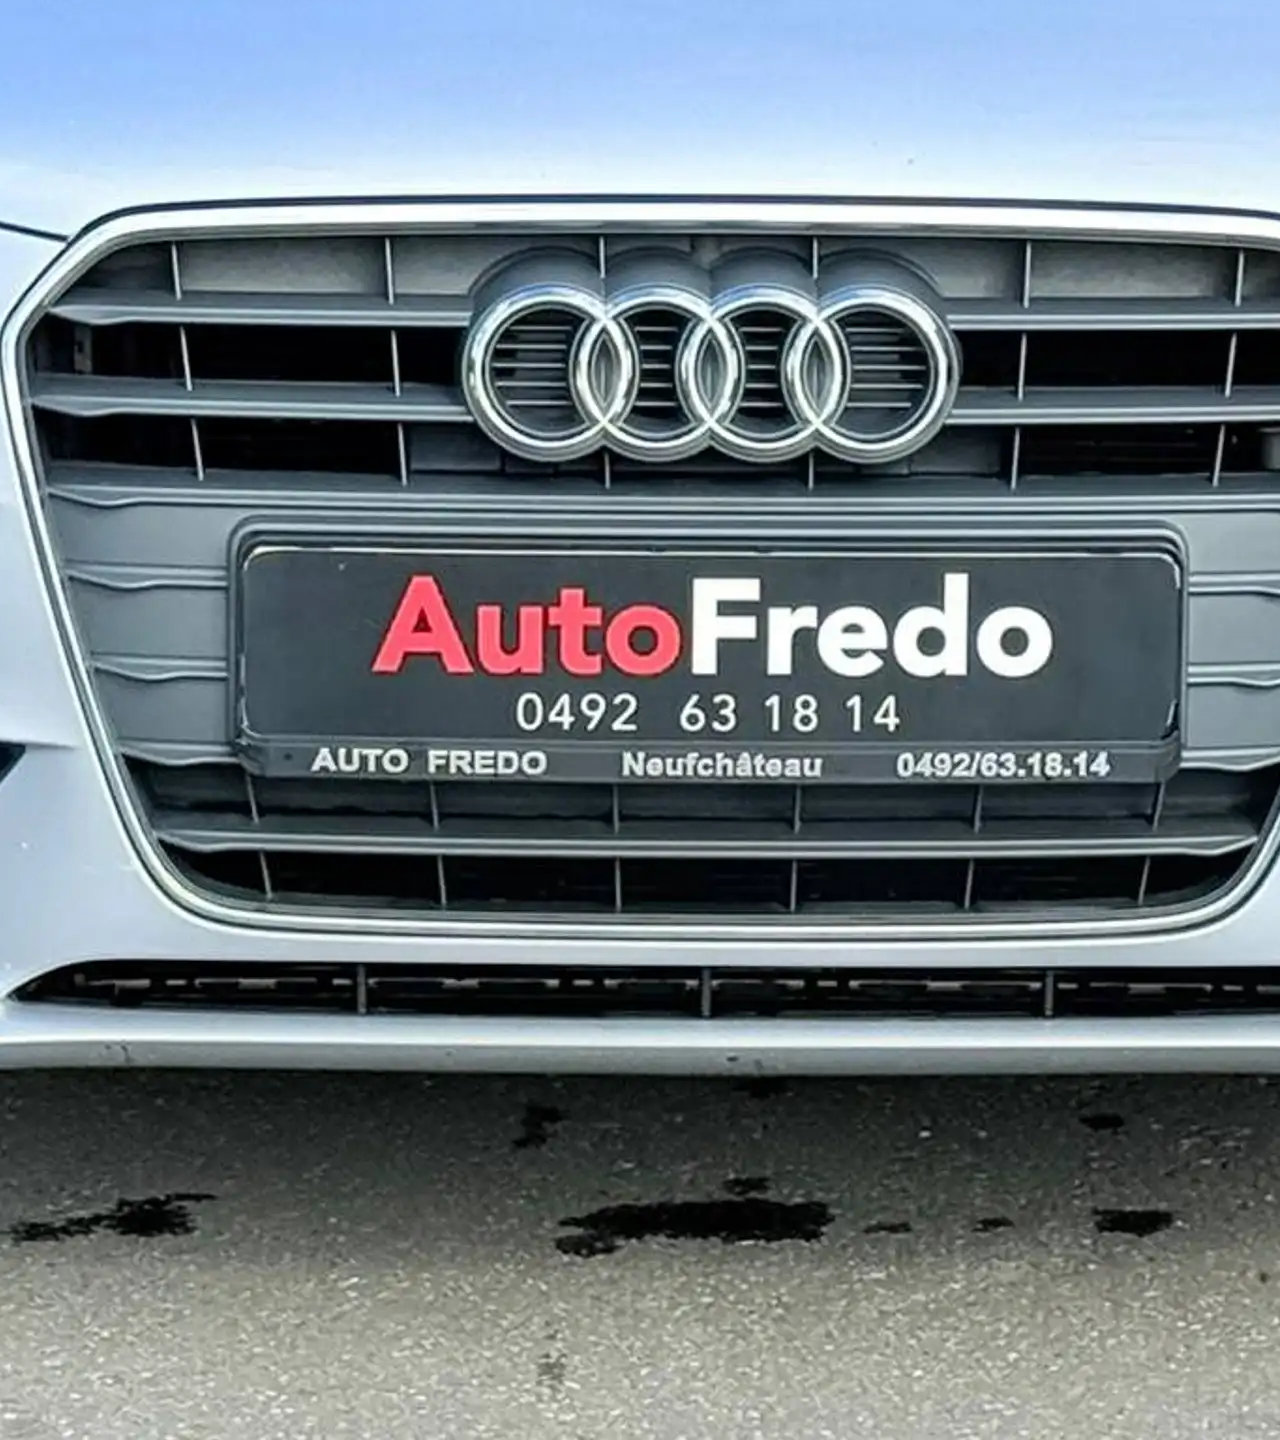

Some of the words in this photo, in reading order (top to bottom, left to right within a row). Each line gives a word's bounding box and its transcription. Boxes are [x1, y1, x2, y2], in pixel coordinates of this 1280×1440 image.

[370, 572, 1054, 678] AutoFredo
[516, 691, 639, 732] 0492
[679, 693, 737, 733] 63
[764, 694, 819, 733] 18
[845, 694, 901, 733] 14
[311, 747, 410, 774] AUTO
[426, 749, 549, 776] FREDO
[621, 750, 823, 778] Neufchâteau
[895, 750, 1111, 778] 0492/63.18.14
